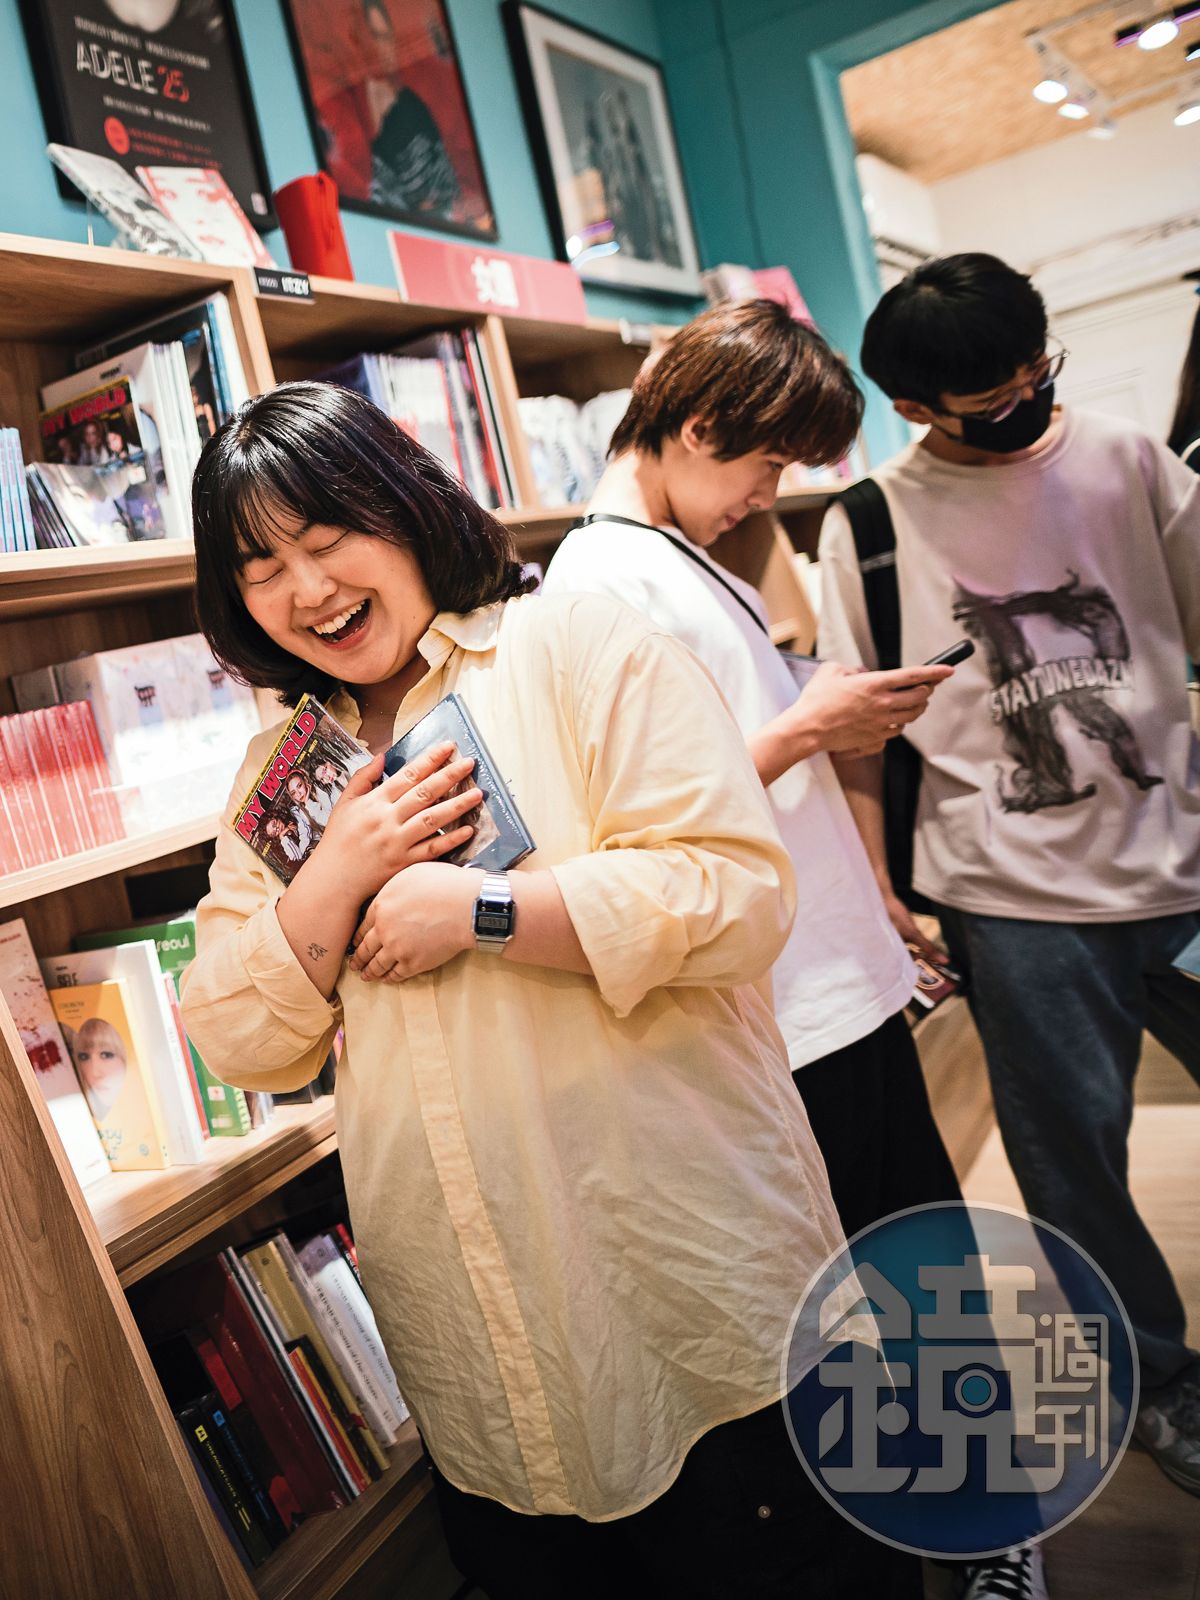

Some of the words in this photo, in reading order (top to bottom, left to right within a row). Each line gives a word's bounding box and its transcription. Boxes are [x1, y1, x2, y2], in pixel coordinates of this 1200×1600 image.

[75, 40, 158, 95] ADELE
[156, 65, 190, 103] 25
[236, 793, 266, 843] MY
[258, 711, 317, 801] WORLD
